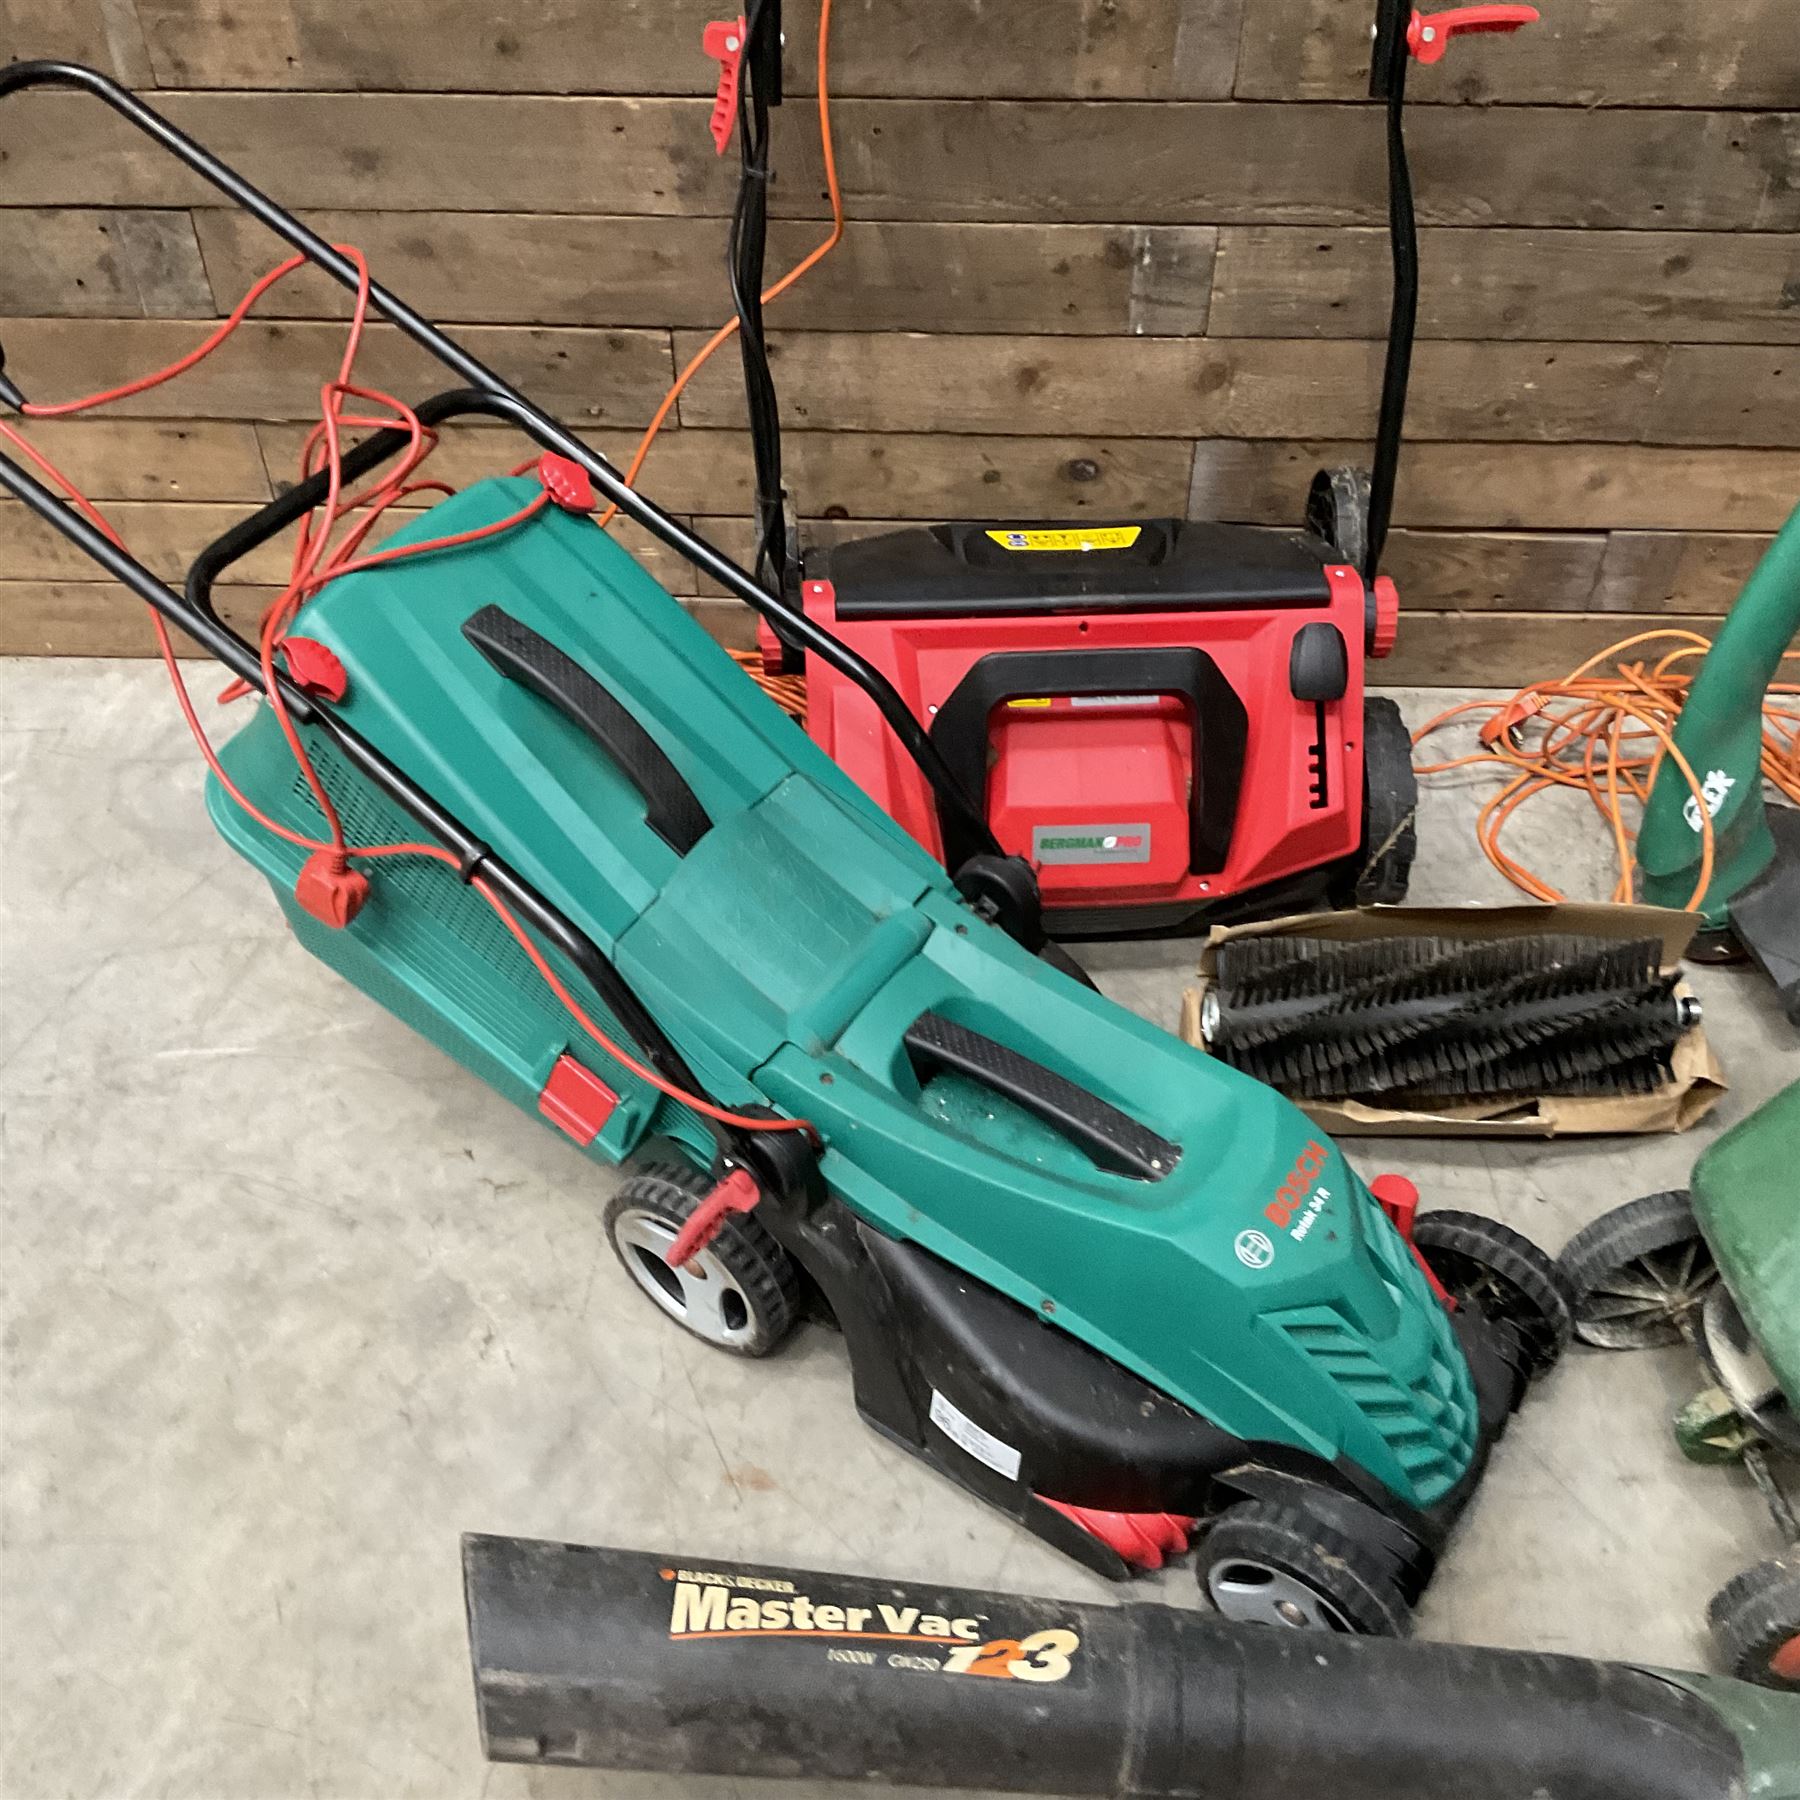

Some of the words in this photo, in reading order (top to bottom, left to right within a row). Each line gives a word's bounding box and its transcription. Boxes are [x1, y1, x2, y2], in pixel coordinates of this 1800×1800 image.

[1040, 837, 1104, 850] BERGMAN
[1116, 835, 1142, 848] PRO
[1264, 1140, 1329, 1229] BOSCH
[1290, 1210, 1318, 1242] Rotak
[670, 1582, 873, 1634] Master
[876, 1604, 981, 1641] Vac
[941, 1629, 1081, 1682] 123
